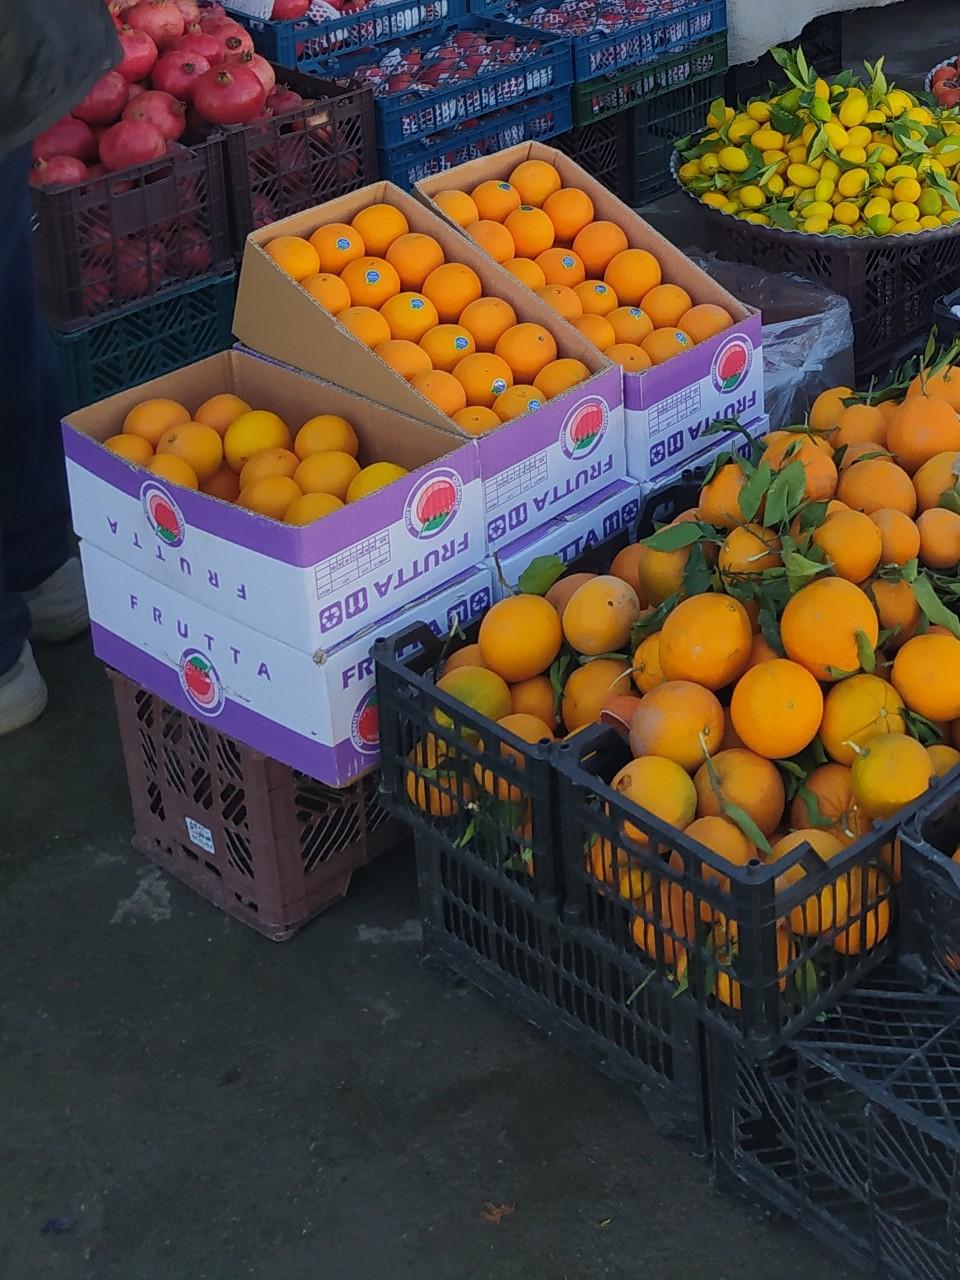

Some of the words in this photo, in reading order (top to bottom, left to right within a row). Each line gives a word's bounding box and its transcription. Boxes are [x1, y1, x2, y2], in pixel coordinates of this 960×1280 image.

[532, 454, 613, 512] FRUTTA
[106, 516, 248, 601] FRUTTA
[373, 531, 469, 599] FRUTTA
[129, 594, 272, 681] FRUTTA
